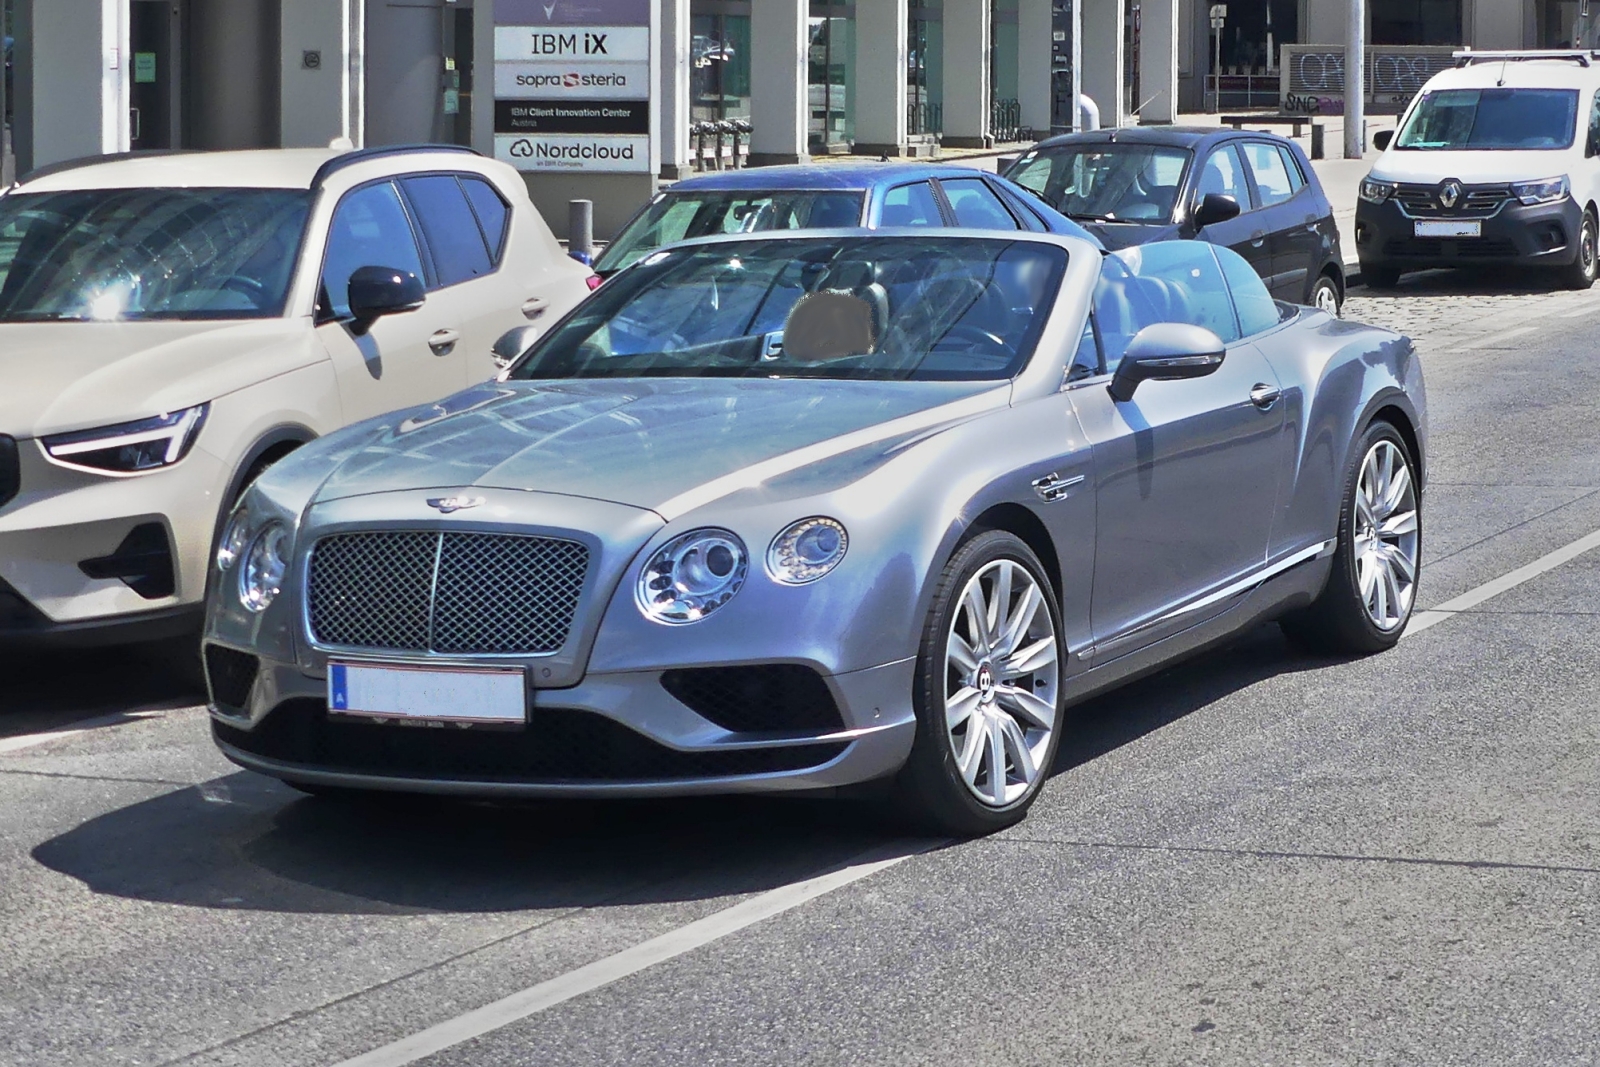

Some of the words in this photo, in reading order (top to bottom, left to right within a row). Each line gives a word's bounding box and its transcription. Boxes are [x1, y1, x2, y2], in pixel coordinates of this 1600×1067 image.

[532, 34, 576, 54] IBM
[584, 33, 608, 54] iX
[516, 74, 561, 88] sopra
[581, 73, 626, 86] steria
[511, 108, 528, 117] IBM
[529, 108, 554, 117] Client
[555, 108, 600, 117] Innovation
[601, 108, 631, 117] Center
[511, 119, 537, 127] Austria
[536, 143, 633, 159] Nordcloud
[336, 692, 344, 703] A
